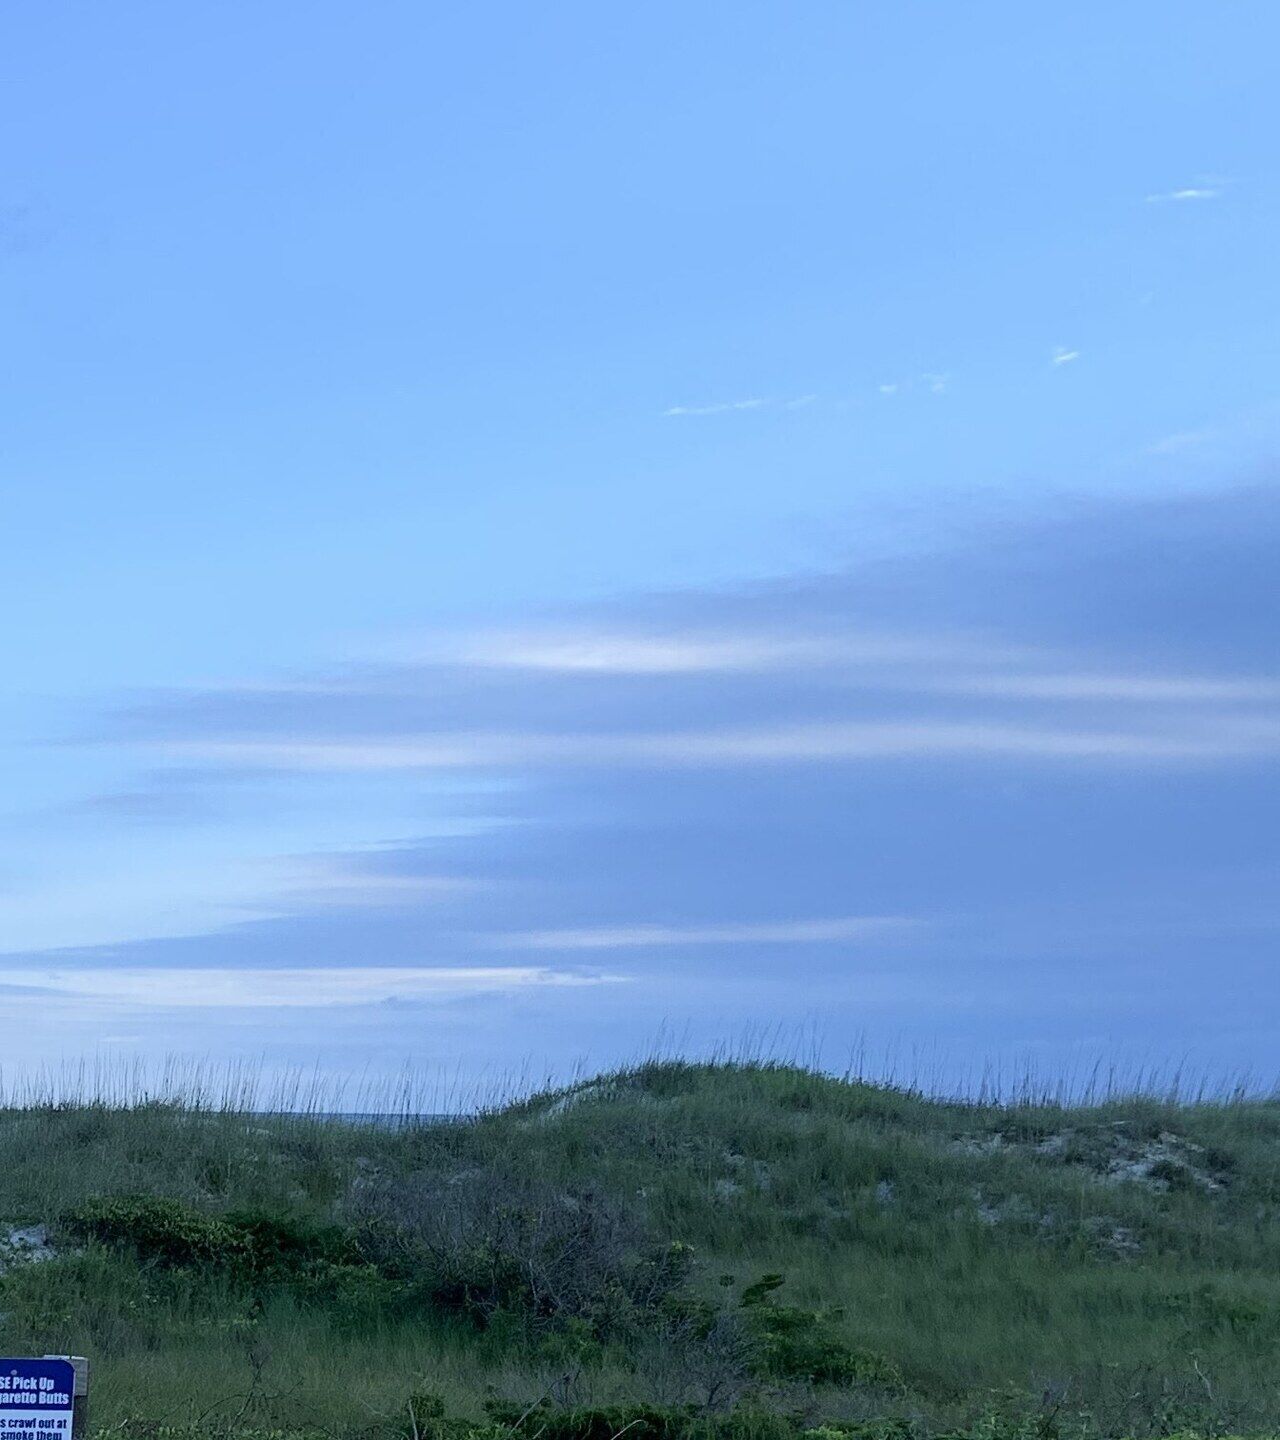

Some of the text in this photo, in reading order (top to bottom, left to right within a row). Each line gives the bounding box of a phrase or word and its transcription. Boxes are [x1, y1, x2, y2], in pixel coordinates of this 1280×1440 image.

[12, 1377, 37, 1390] Pick
[39, 1377, 55, 1391] Up
[39, 1391, 69, 1404] Butts
[8, 1418, 36, 1428] crawl
[38, 1419, 55, 1429] out
[56, 1419, 67, 1429] at
[0, 1430, 34, 1440] smoke
[36, 1431, 62, 1440] them
